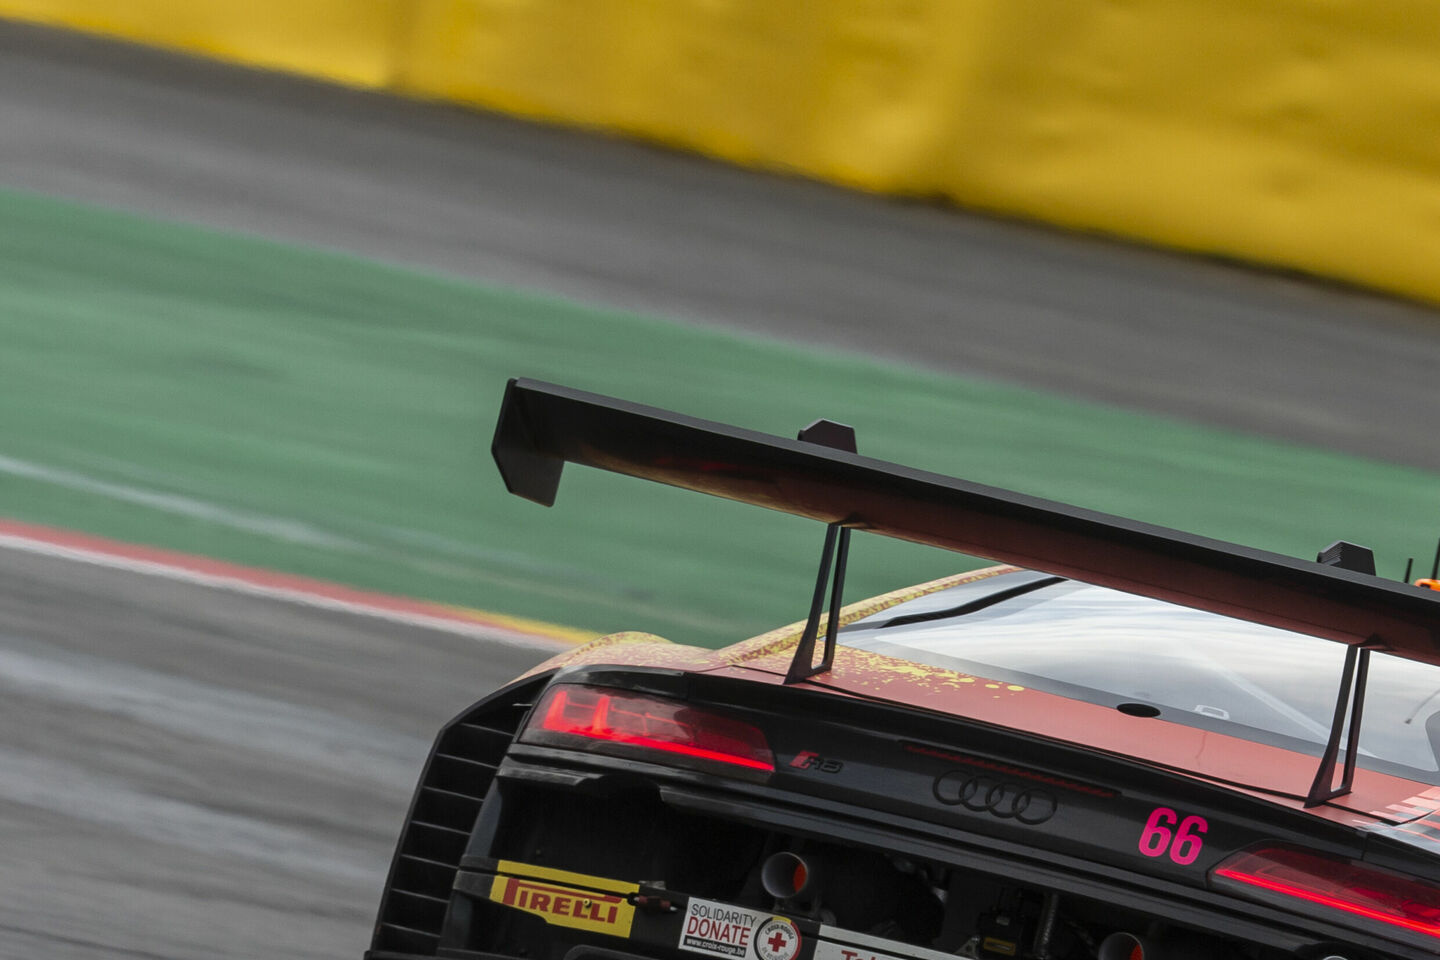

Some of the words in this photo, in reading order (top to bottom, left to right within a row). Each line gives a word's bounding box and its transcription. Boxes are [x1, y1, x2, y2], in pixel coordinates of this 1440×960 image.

[1138, 807, 1209, 866] 66
[502, 878, 623, 924] PIRELLI
[691, 903, 757, 927] SOLIDARITY
[686, 916, 752, 947] DONATE
[686, 938, 746, 957] www.croix-rouge.be
